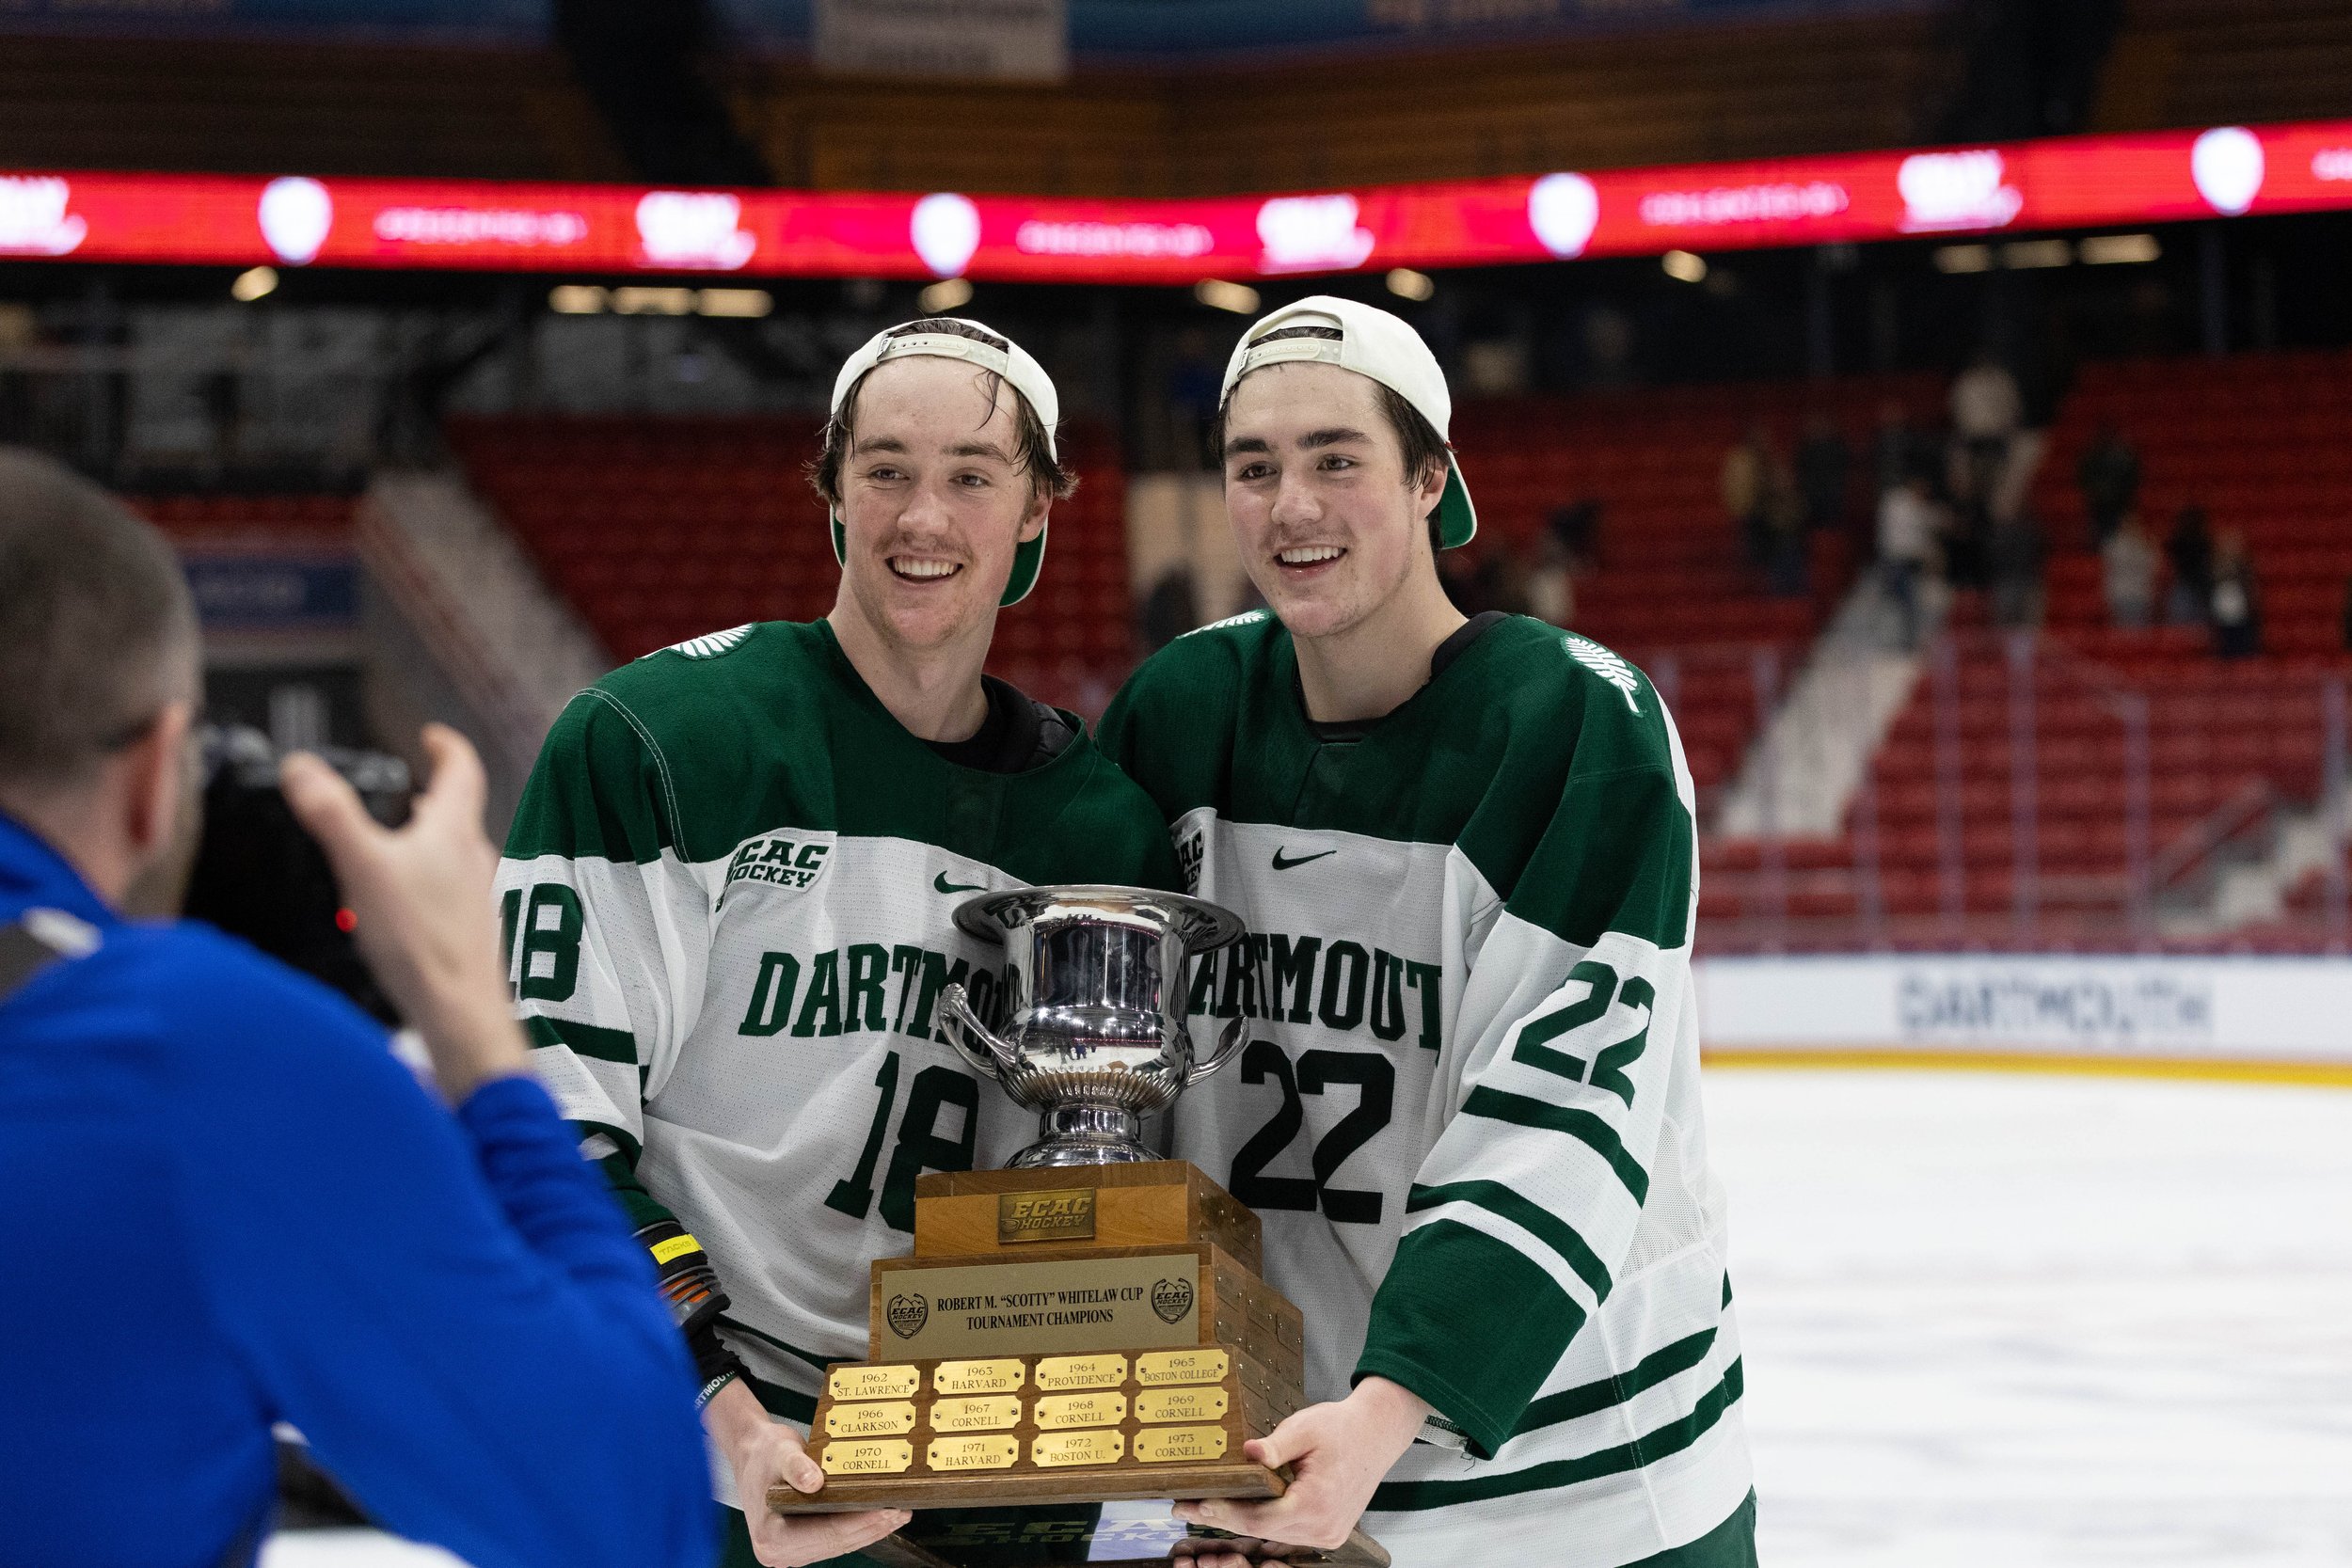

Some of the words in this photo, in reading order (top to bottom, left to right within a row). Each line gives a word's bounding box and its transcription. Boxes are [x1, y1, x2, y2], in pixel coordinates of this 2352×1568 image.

[730, 839, 830, 870] CAC
[726, 864, 816, 888] OCKEY
[500, 882, 584, 1003] 18
[738, 942, 1003, 1056] DARTMO
[1188, 931, 1442, 1068] ARTMOUT
[1895, 974, 2213, 1037] DARTMOUTH
[1512, 960, 1655, 1111] 22
[1229, 1040, 1394, 1224] 22
[823, 1050, 979, 1234] 18
[1011, 1197, 1091, 1218] ECAC
[1019, 1215, 1085, 1229] HOCKEY
[937, 1296, 982, 1311] ROBERT
[985, 1296, 997, 1308] M.
[1057, 1288, 1119, 1305] WHITELAW
[1121, 1287, 1143, 1301] CUP
[892, 1307, 926, 1315] ECAC
[966, 1313, 1044, 1330] TOURNAMENT
[1047, 1309, 1114, 1325] CHAMPIONS
[1069, 1363, 1095, 1372] 1964
[1169, 1358, 1196, 1368] 1965
[967, 1367, 993, 1376] 1963
[1144, 1370, 1177, 1382] BOSTON
[1180, 1369, 1218, 1380] COLLEGE
[862, 1373, 888, 1383] 1962
[952, 1378, 1007, 1389] HARVARD
[1048, 1373, 1116, 1386] PROVIDENCE
[837, 1387, 851, 1397] ST.
[855, 1385, 910, 1396] LAWRENCE
[1068, 1401, 1093, 1410] 1968
[1168, 1395, 1195, 1405] 1969
[858, 1410, 883, 1419] 1966
[964, 1404, 991, 1414] 1967
[1155, 1407, 1205, 1418] CORNELL
[952, 1417, 1000, 1427] CORNELL
[1056, 1412, 1104, 1424] CORNELL
[841, 1420, 898, 1433] CLARKSON
[1065, 1438, 1091, 1449] 1972
[1168, 1434, 1195, 1444] 1973
[855, 1448, 882, 1457] 1970
[962, 1443, 985, 1452] 1971
[1155, 1447, 1205, 1457] CORNELL
[946, 1455, 1001, 1466] HARVARD
[1050, 1451, 1092, 1462] BOSTON
[1096, 1449, 1105, 1459] U.
[843, 1459, 891, 1470] CORNELL
[943, 1518, 1223, 1535] ECA
